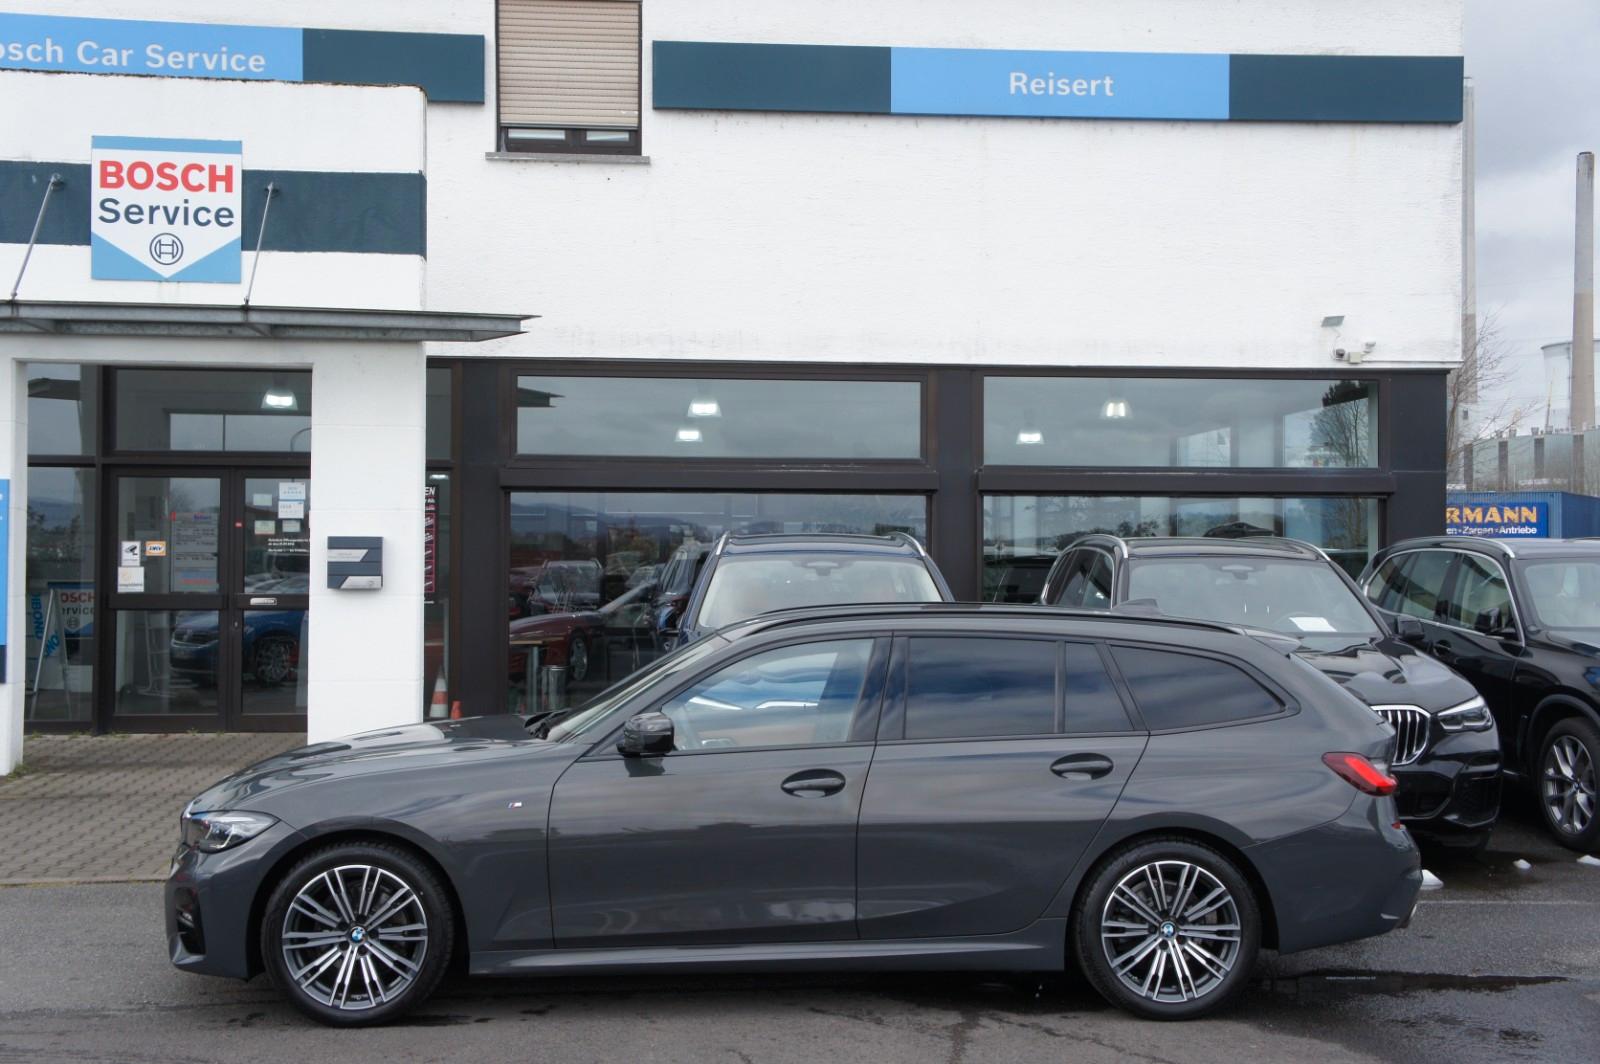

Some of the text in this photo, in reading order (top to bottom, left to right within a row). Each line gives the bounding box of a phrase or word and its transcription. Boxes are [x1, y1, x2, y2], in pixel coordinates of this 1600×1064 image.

[76, 40, 134, 67] Car
[145, 43, 266, 72] Service
[1009, 71, 1115, 97] Reisert
[99, 160, 234, 193] BOSCH
[98, 197, 235, 228] Service
